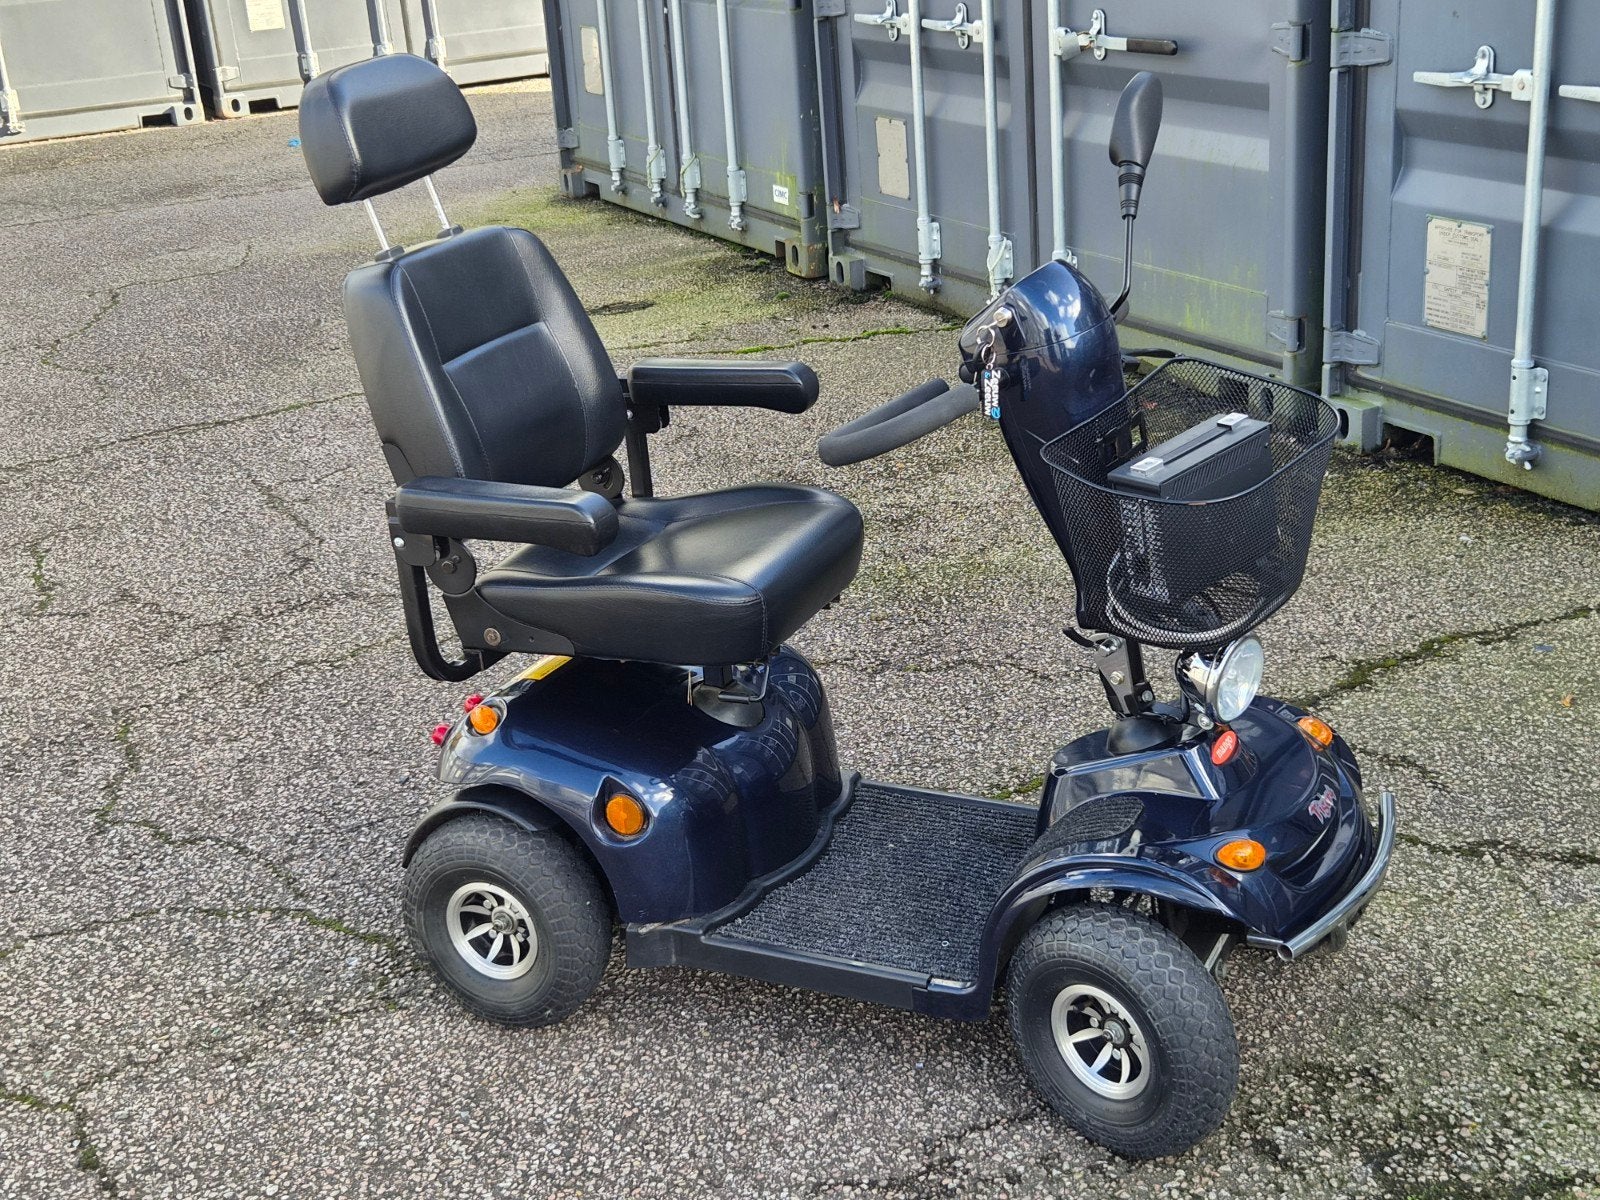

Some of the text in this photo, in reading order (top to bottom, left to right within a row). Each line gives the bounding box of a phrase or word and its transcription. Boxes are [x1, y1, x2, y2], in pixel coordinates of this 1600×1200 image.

[984, 378, 993, 416] Zeeuw
[991, 369, 1001, 407] Zeeuw
[1215, 735, 1233, 759] mango
